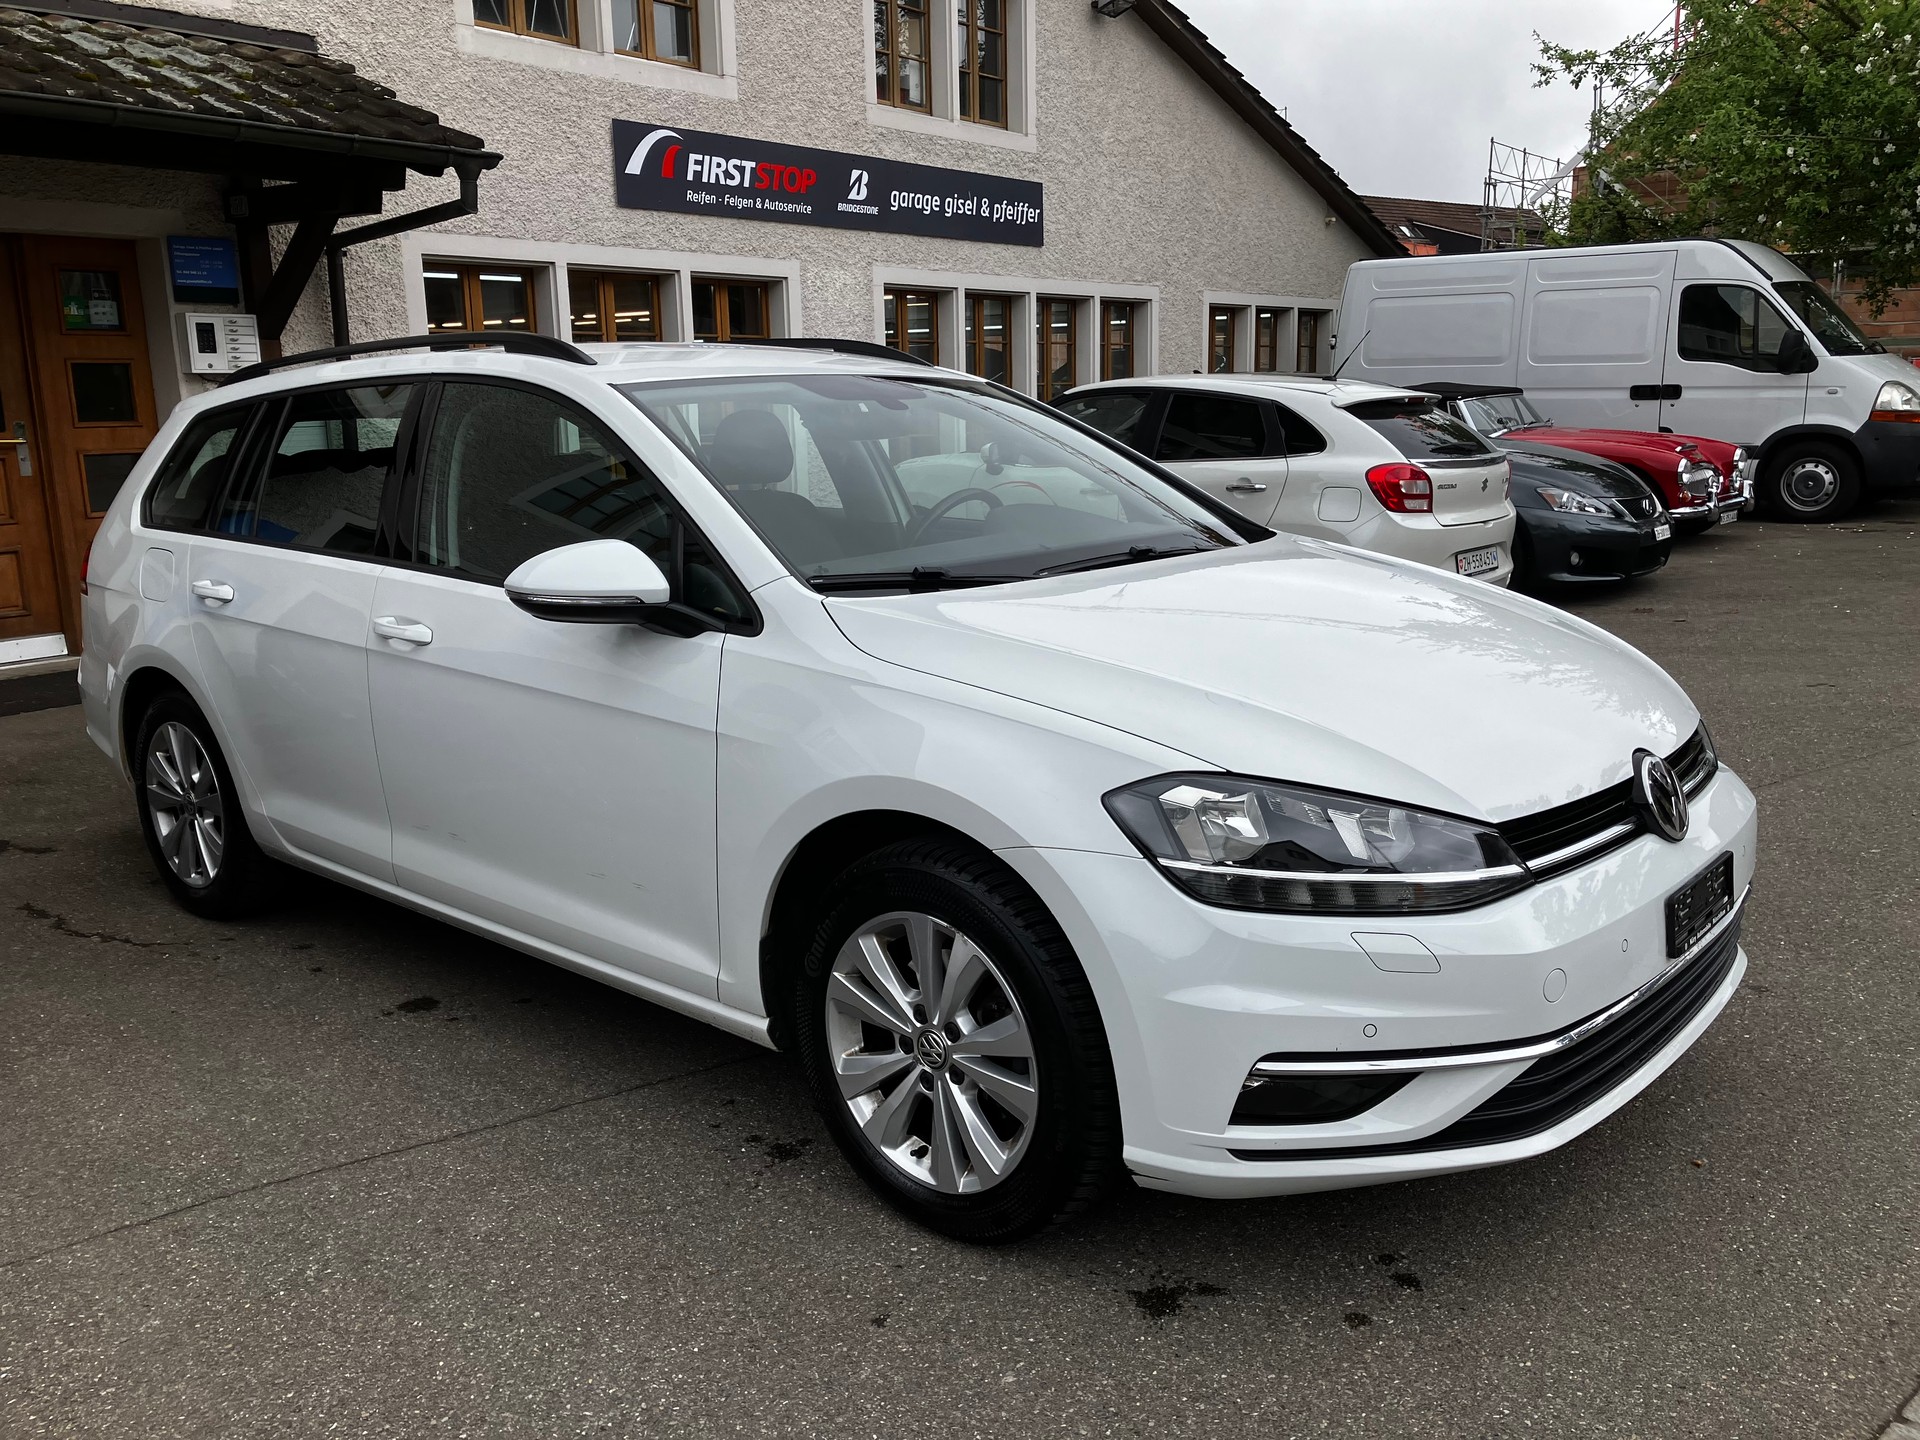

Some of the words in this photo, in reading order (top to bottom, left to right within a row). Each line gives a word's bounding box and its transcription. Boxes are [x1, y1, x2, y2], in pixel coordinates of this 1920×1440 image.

[686, 190, 716, 205] Reifen
[724, 194, 753, 210] Felgen
[755, 197, 762, 209] &
[764, 199, 812, 214] Autoservice
[837, 202, 879, 215] BRIDGESTONE
[890, 190, 940, 215] garage
[944, 193, 977, 217] gisel
[980, 198, 990, 217] &
[993, 200, 1040, 225] pfeiffer
